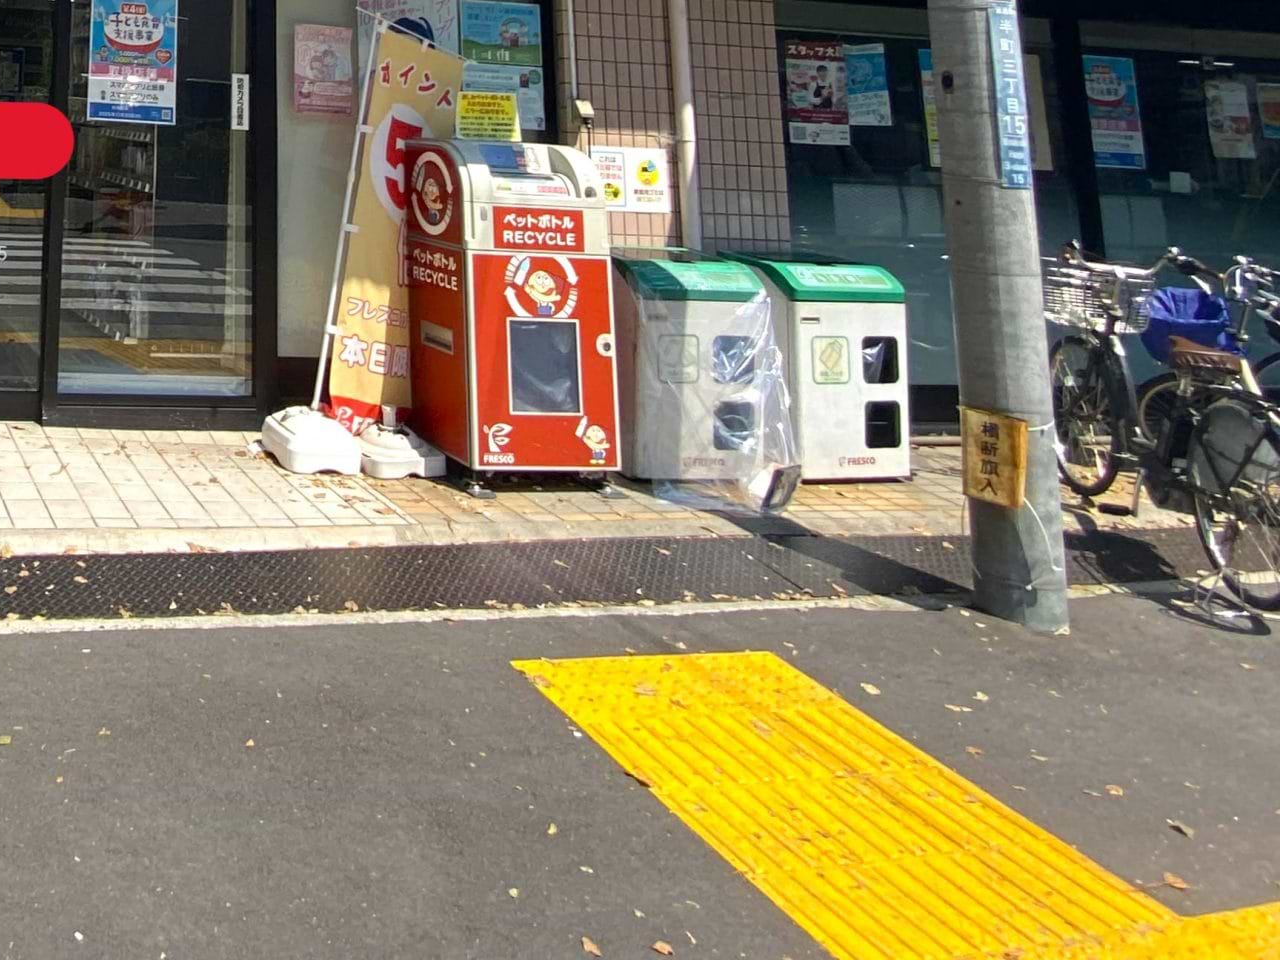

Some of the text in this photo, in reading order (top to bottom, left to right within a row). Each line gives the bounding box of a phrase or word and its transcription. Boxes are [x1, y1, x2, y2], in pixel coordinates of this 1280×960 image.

[1002, 116, 1026, 135] 15
[503, 213, 575, 229] ペットボトル
[503, 230, 577, 246] RECYCLE
[413, 248, 457, 271] ペットボトル
[412, 265, 458, 291] RECYCLE
[483, 454, 515, 464] FRESCO
[847, 456, 877, 466] FRESCO
